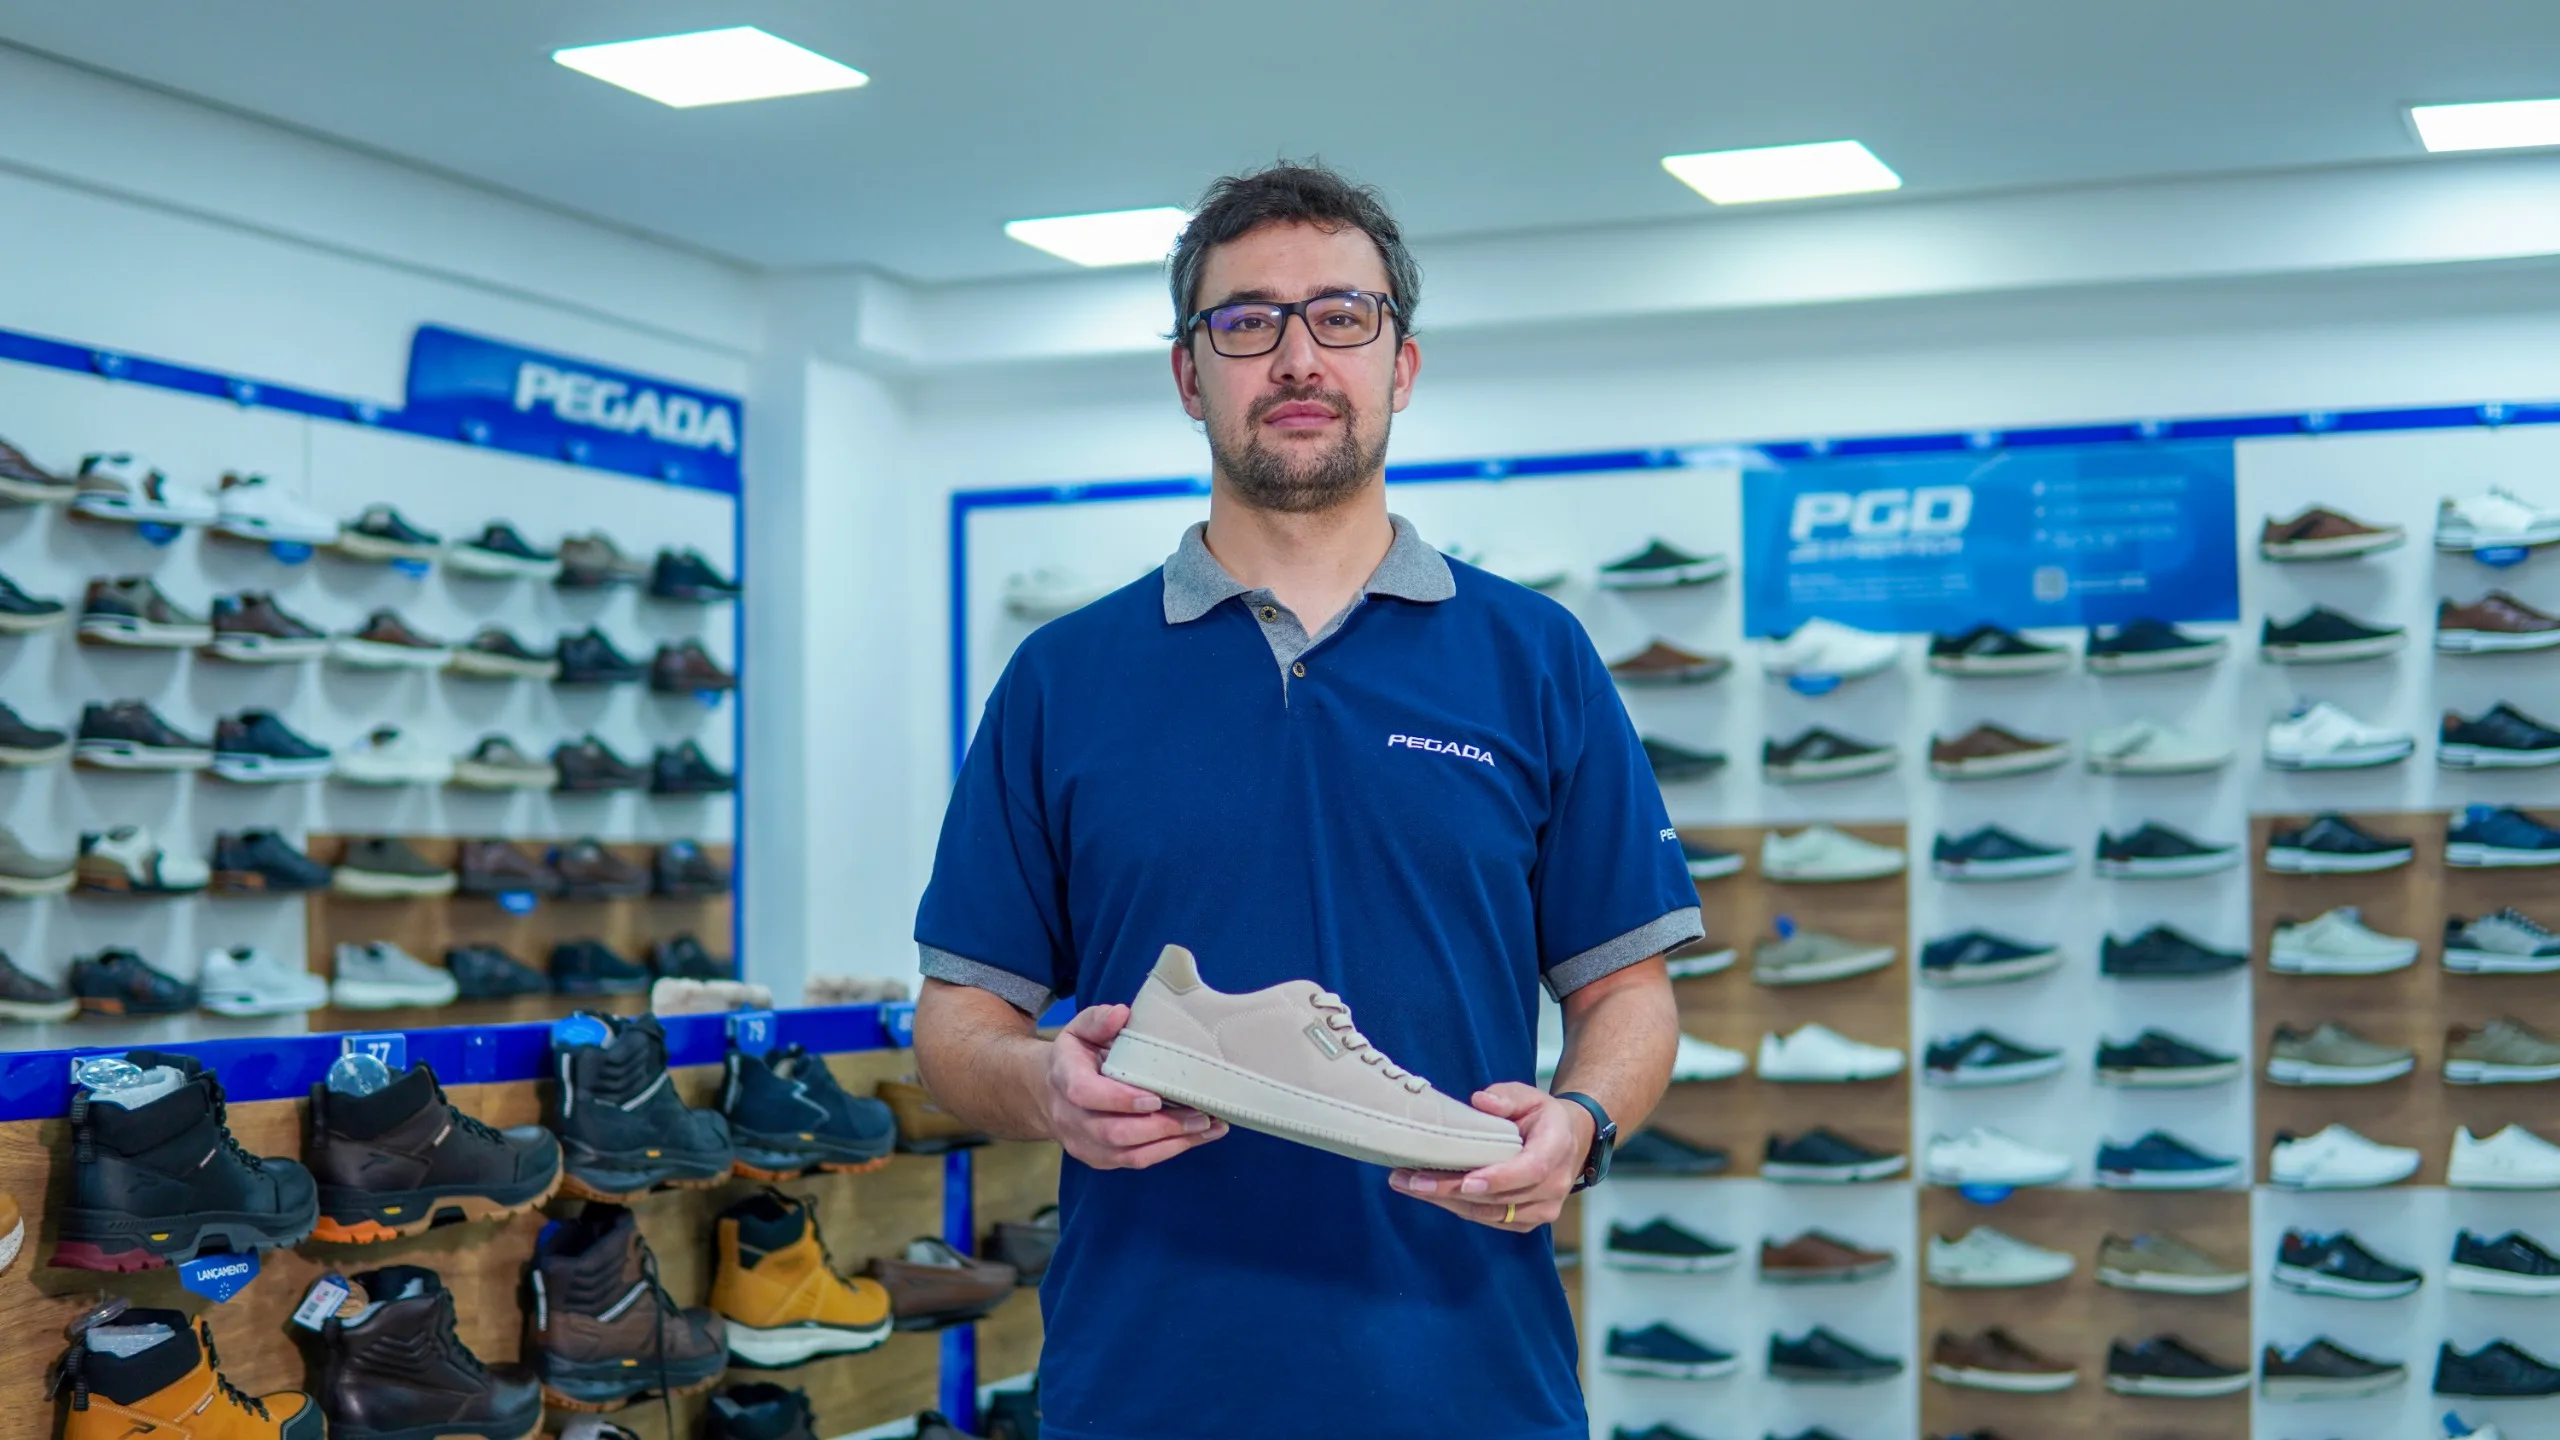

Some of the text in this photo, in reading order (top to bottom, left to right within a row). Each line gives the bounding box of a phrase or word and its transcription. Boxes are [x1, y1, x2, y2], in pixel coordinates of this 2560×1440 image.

[515, 360, 736, 454] PEGADA
[1789, 485, 1974, 543] PGD
[1387, 734, 1495, 767] PEGADA
[367, 1041, 391, 1064] 77
[196, 1262, 249, 1281] LANÇAMENTO
